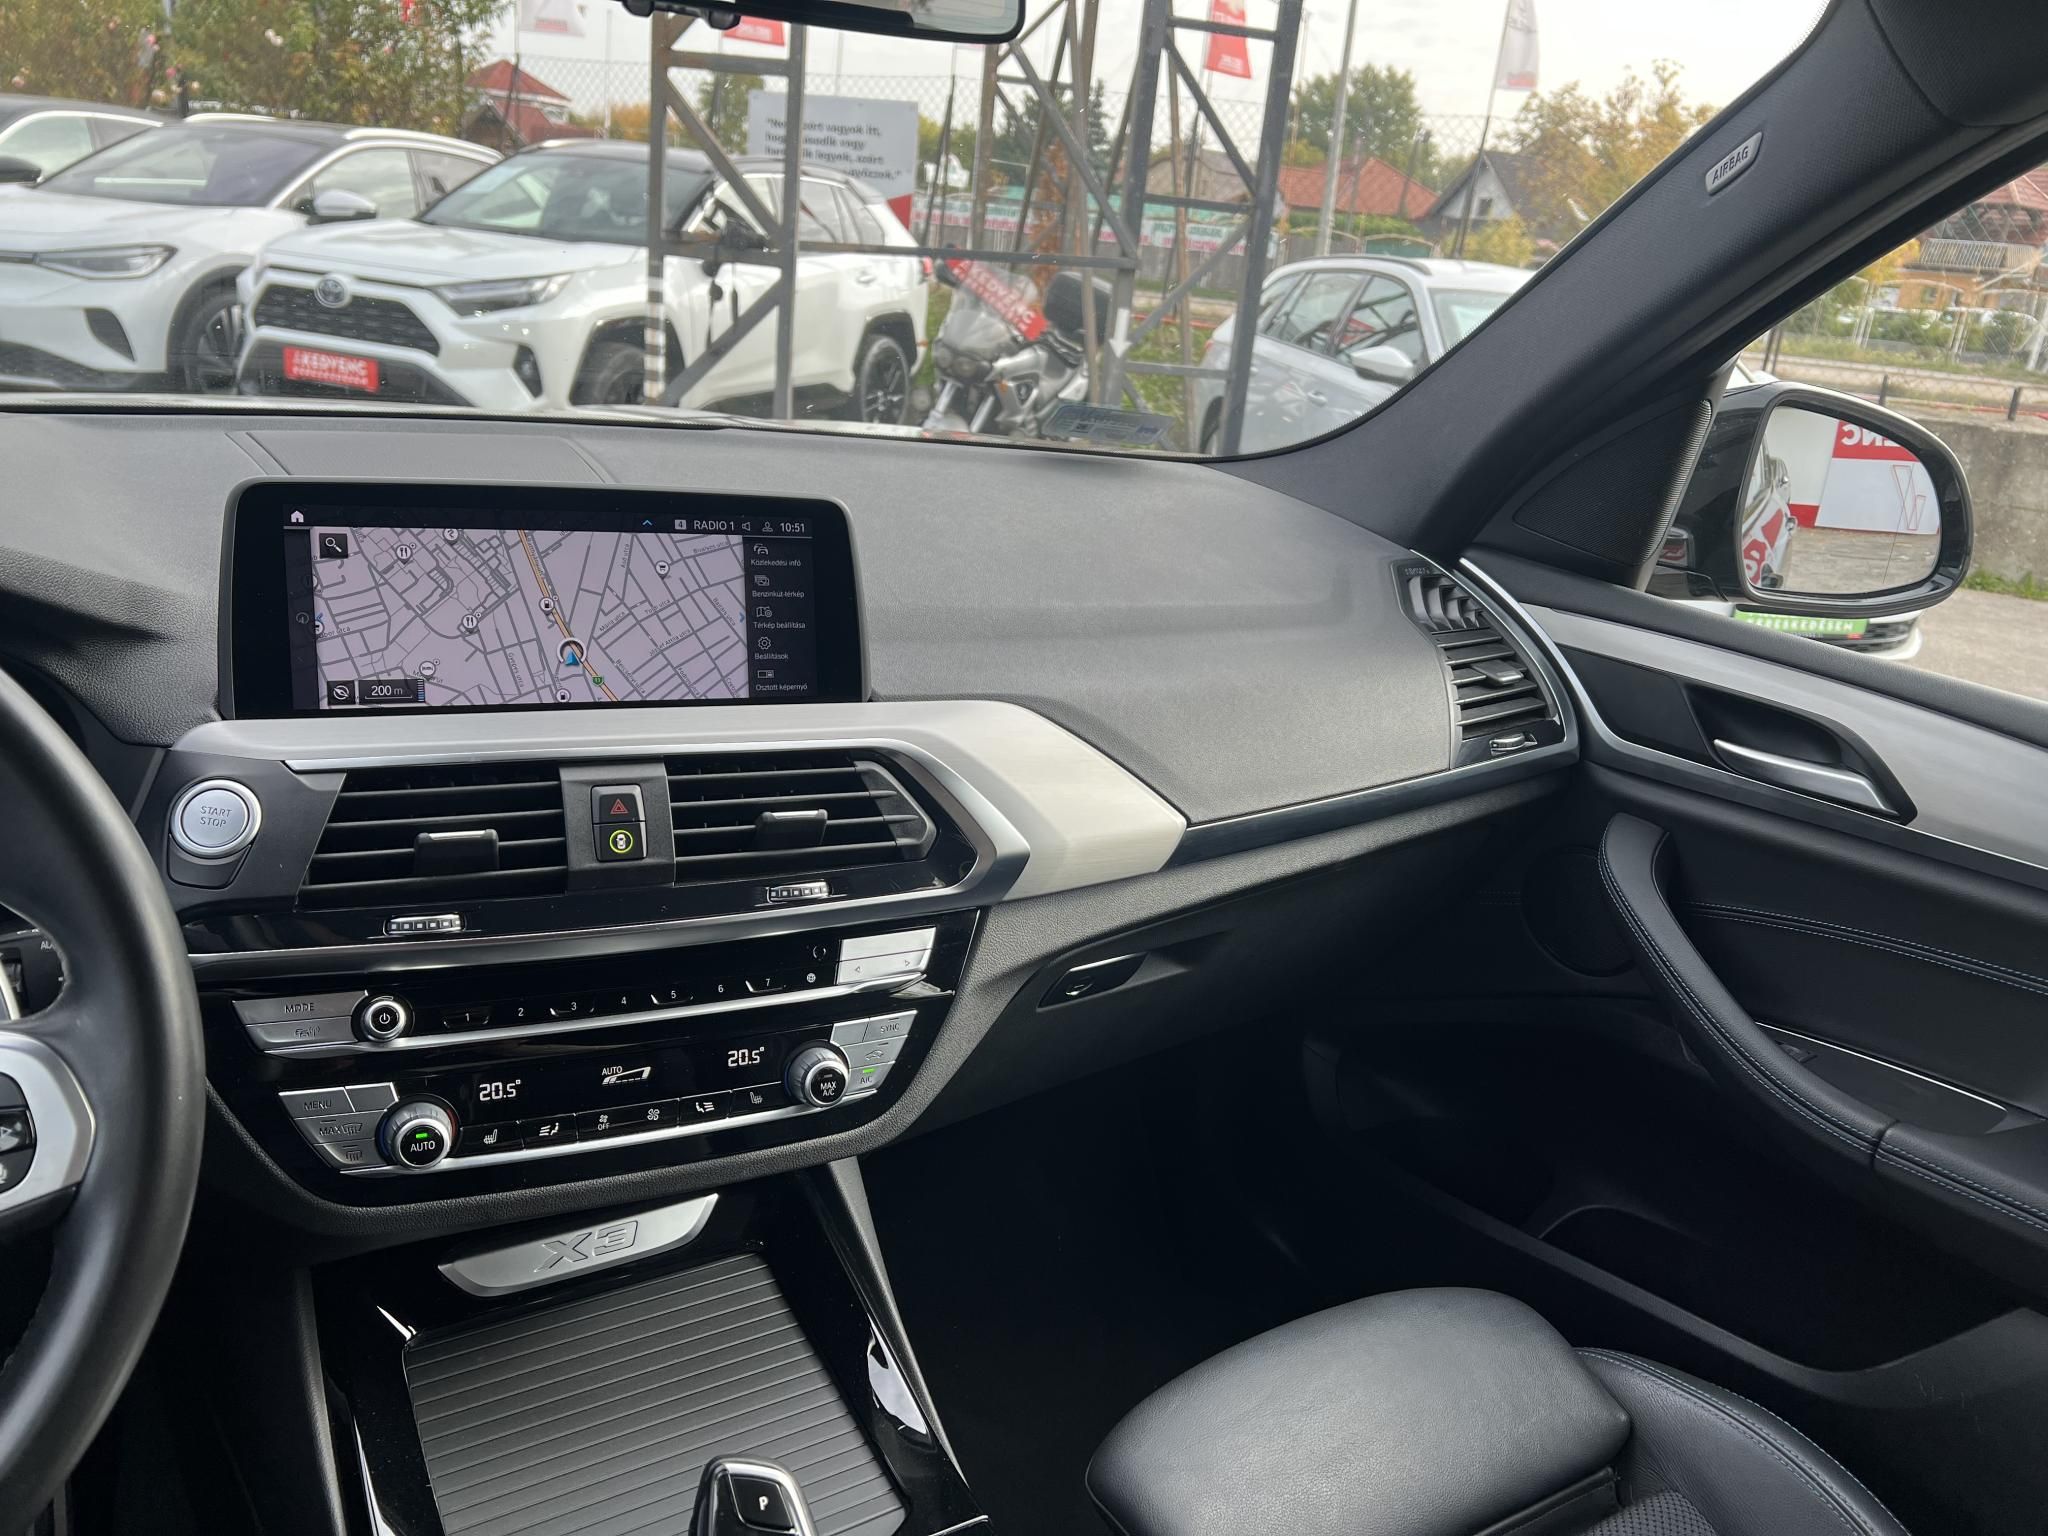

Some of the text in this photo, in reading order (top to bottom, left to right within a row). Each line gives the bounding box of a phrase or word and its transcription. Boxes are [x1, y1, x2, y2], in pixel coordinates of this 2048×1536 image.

[1711, 145, 1749, 185] AIRBAG
[693, 520, 728, 531] RADIO
[729, 521, 735, 531] 1
[779, 522, 806, 533] 10:51
[750, 558, 802, 567] Közlekedési infó
[753, 621, 806, 630] Térkép beállítása
[754, 652, 789, 660] Beállítások
[371, 686, 403, 696] 200 m
[200, 805, 233, 818] START
[200, 816, 227, 828] STOP
[765, 978, 771, 987] 7
[717, 984, 724, 993] 6
[670, 990, 677, 999] 5
[621, 996, 627, 1005] 4
[284, 1002, 315, 1014] MODE
[571, 1002, 577, 1011] 3
[465, 1012, 470, 1022] 1
[518, 1007, 524, 1017] 2
[880, 1022, 900, 1034] SYNC
[601, 1065, 623, 1076] AUTO
[820, 1081, 837, 1091] MAX
[822, 1089, 835, 1097] A/C
[303, 1099, 332, 1111] MENU
[320, 1126, 342, 1137] MAX
[597, 1122, 611, 1131] OFF
[409, 1140, 437, 1153] AUTO
[533, 1220, 639, 1273] X3
[758, 1495, 769, 1511] P
